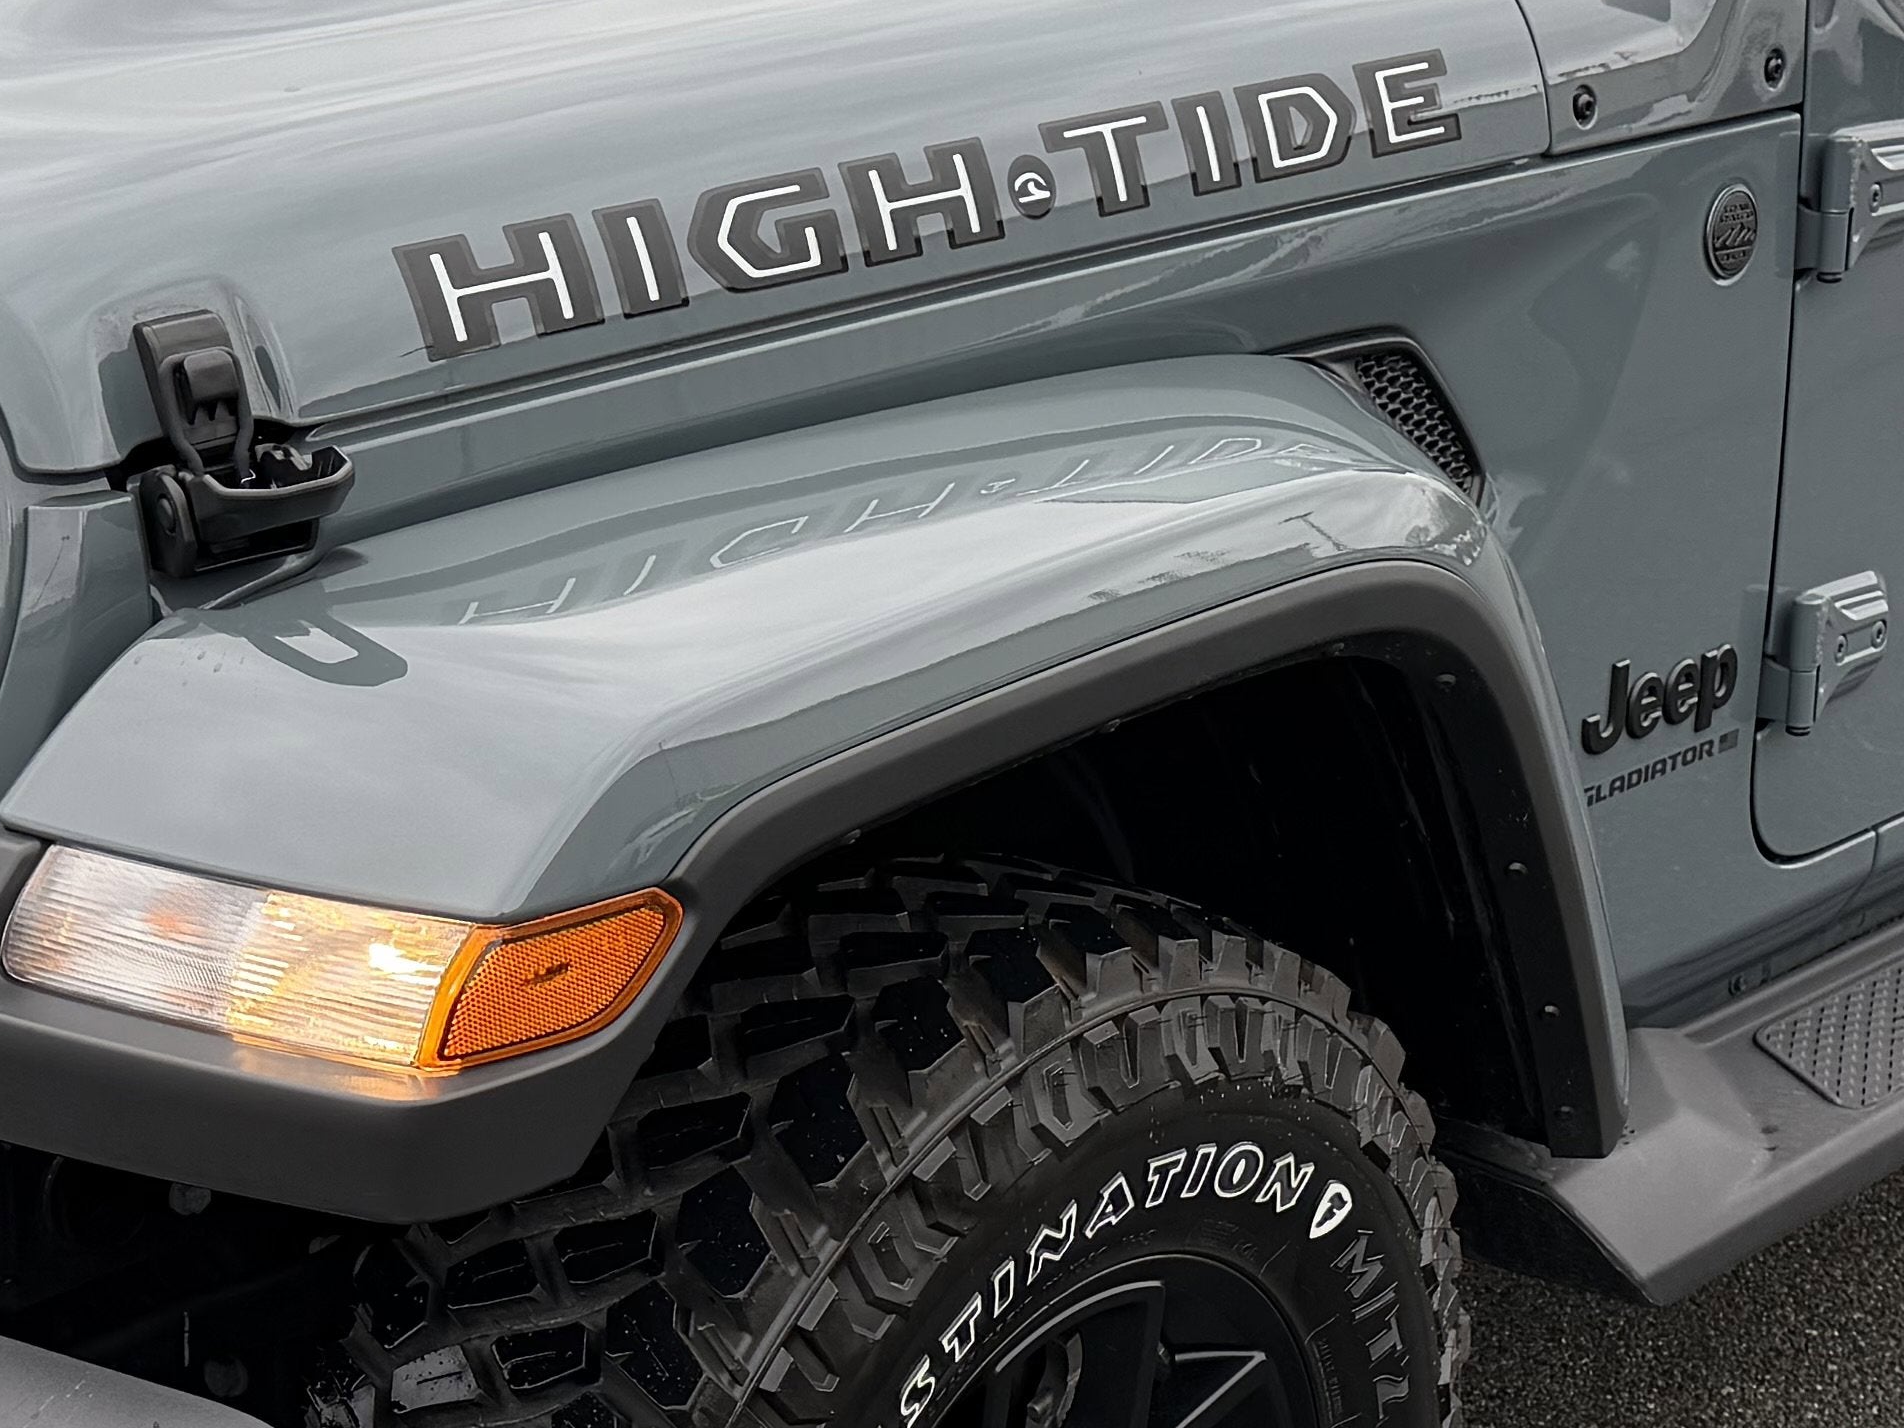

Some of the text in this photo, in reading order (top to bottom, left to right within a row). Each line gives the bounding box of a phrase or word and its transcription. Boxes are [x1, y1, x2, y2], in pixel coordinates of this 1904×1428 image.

[393, 48, 1463, 363] HIGH TIDE
[1581, 643, 1738, 756] Jeep
